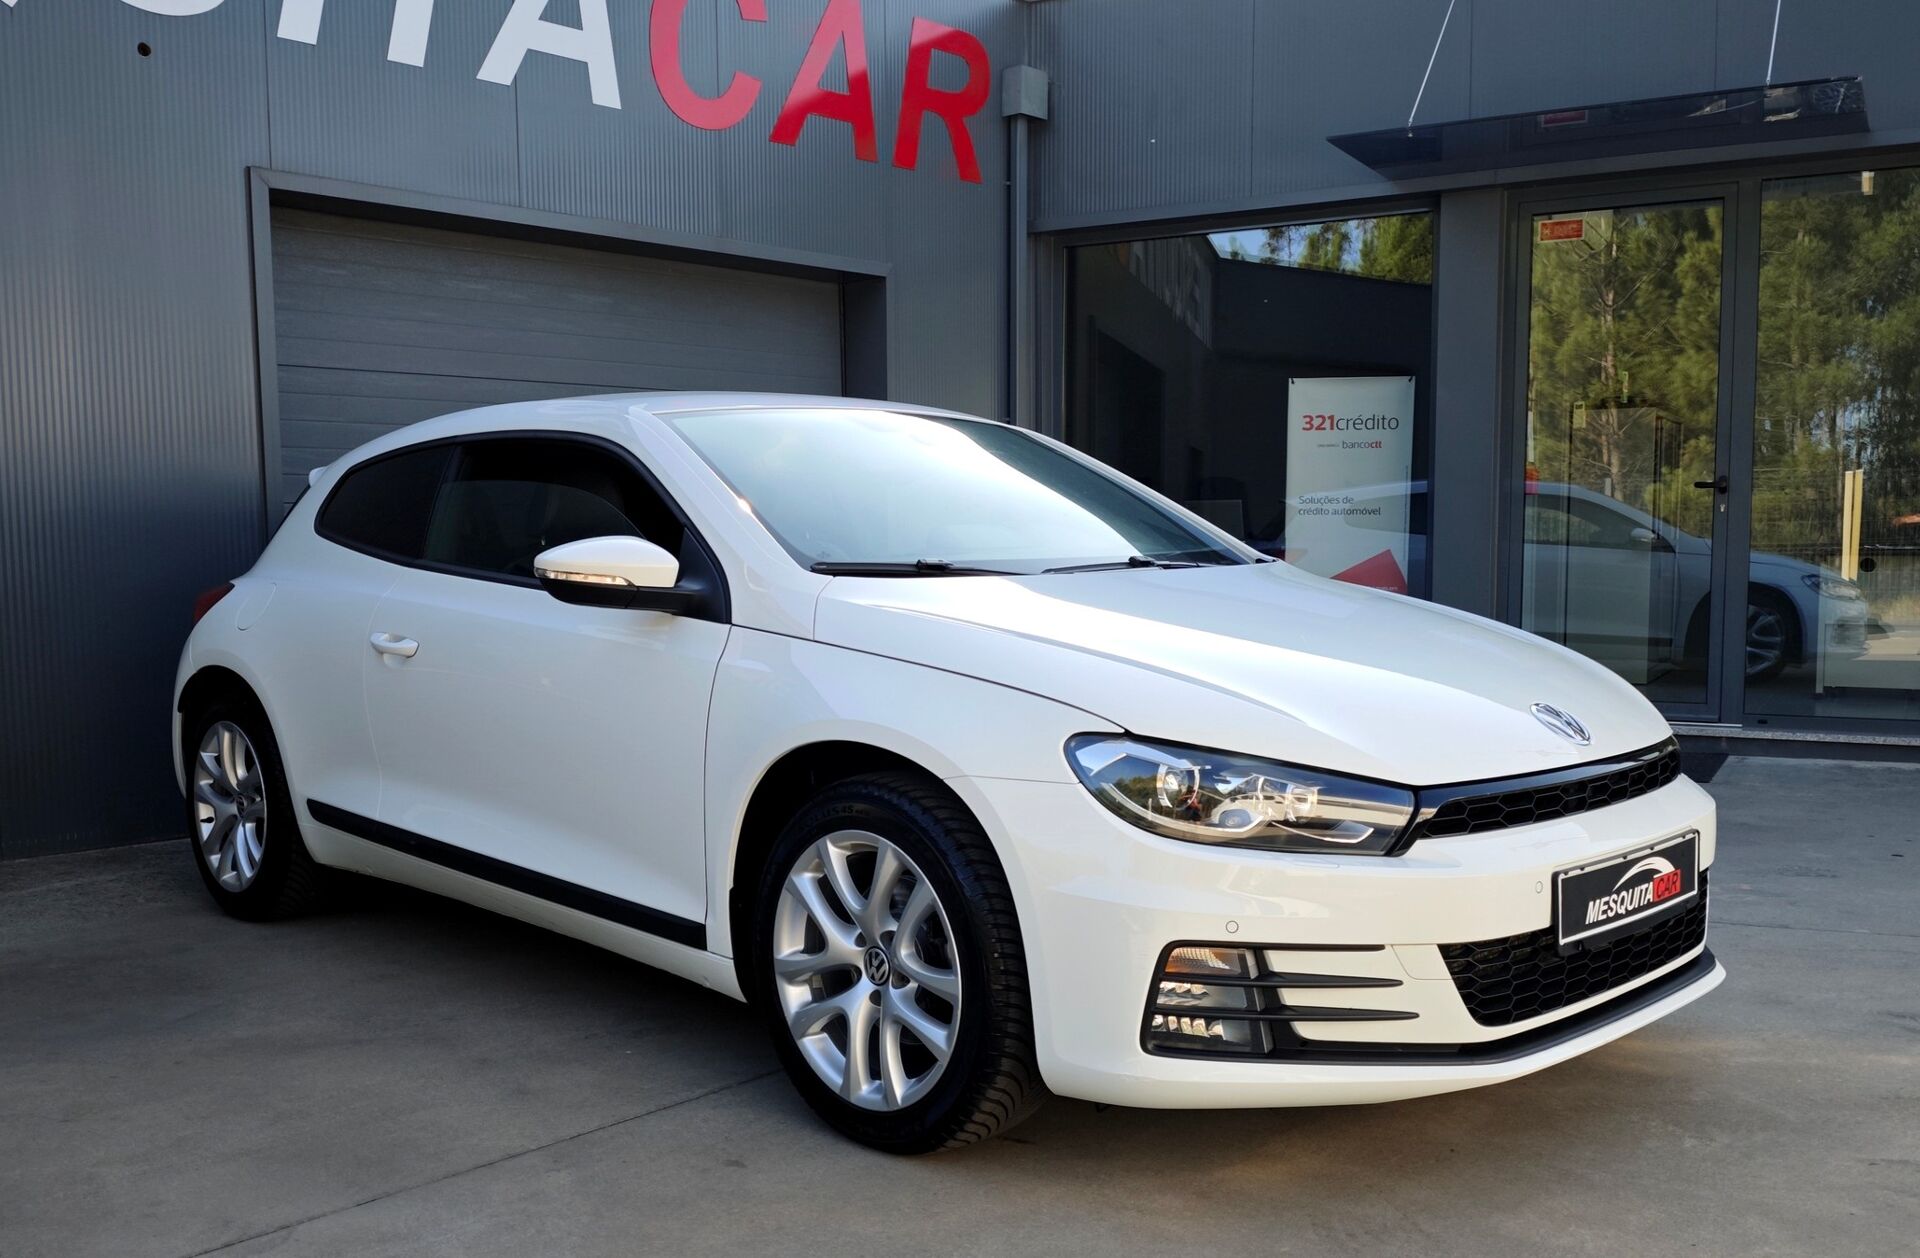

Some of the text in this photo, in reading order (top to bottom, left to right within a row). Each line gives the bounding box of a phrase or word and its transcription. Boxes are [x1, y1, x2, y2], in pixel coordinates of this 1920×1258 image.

[1302, 414, 1400, 431] 321crédito
[1298, 495, 1355, 506] Soluções de
[1298, 507, 1381, 516] crédito automóvel
